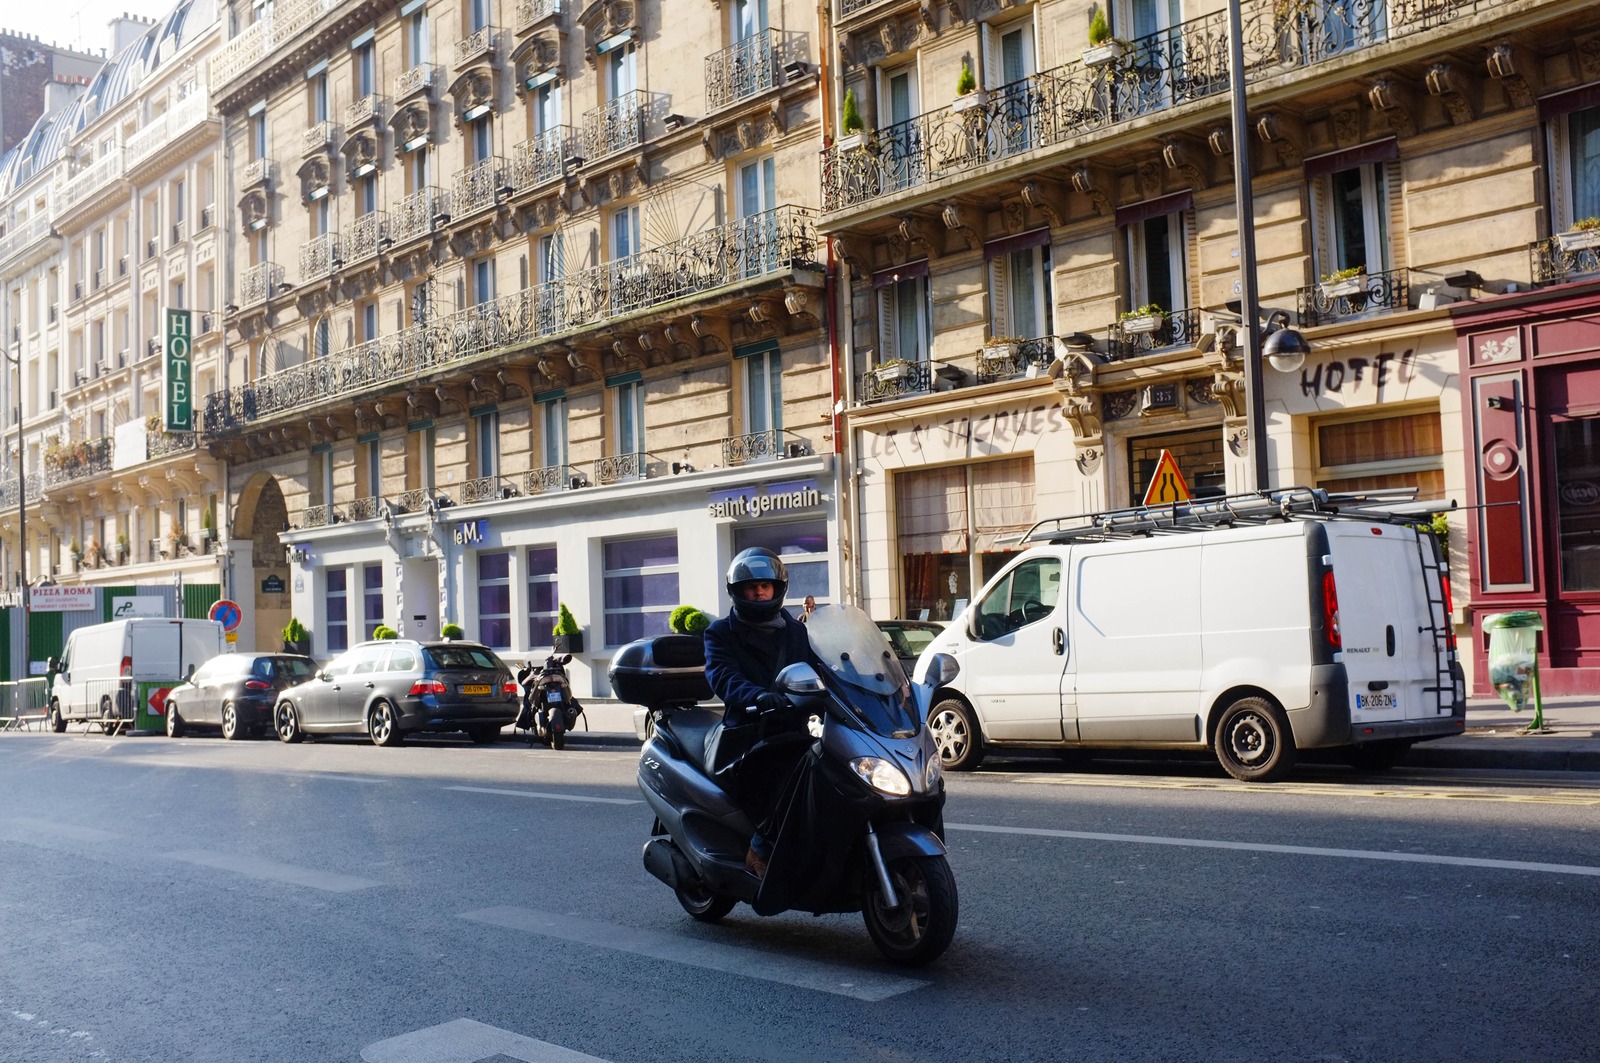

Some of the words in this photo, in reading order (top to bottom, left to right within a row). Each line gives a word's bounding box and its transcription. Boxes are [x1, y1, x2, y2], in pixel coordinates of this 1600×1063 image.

[170, 314, 188, 426] HOTEL
[1300, 348, 1416, 399] HOTEL
[871, 430, 898, 457] LE
[942, 402, 1063, 449] JACQUES
[707, 495, 746, 518] saint
[750, 486, 819, 518] germain
[453, 529, 463, 545] le
[32, 588, 61, 596] PIZZA
[63, 587, 93, 595] ROMA
[1361, 694, 1393, 707] BK-206-ZN
